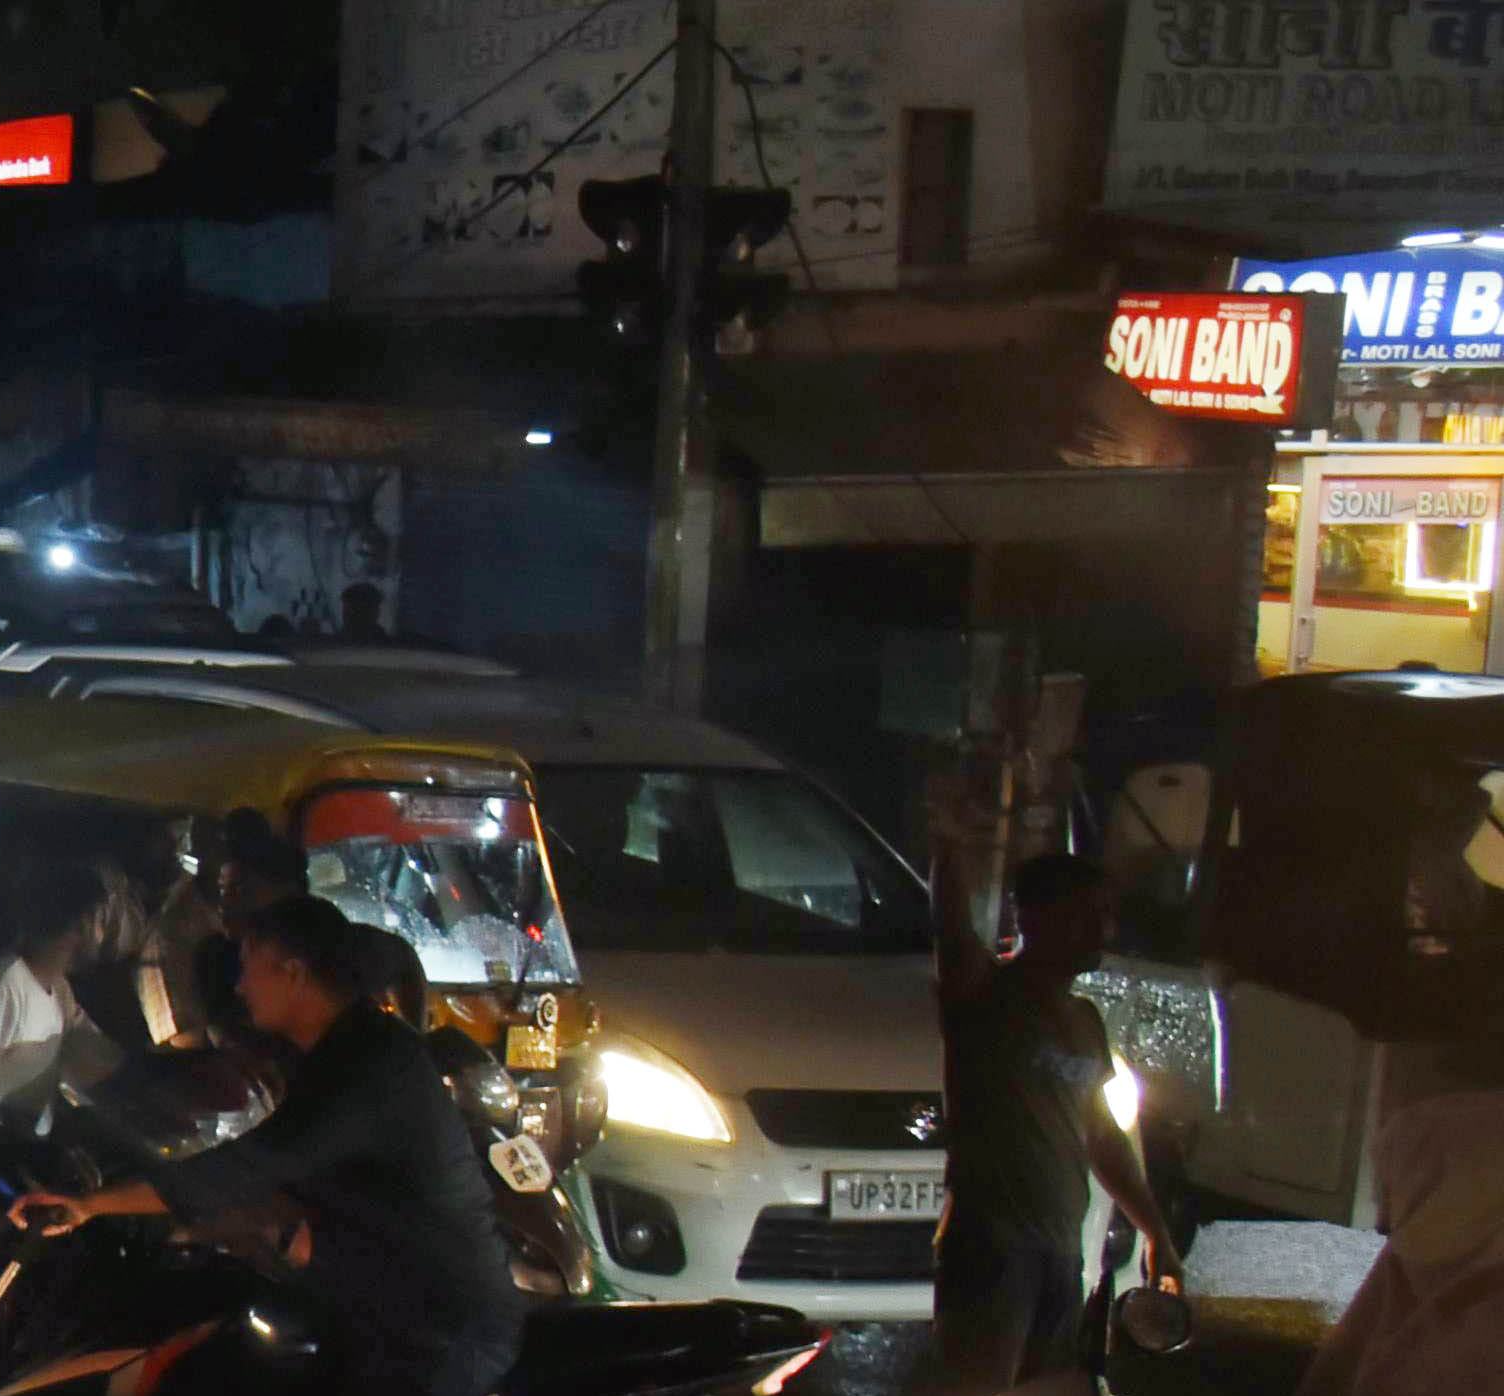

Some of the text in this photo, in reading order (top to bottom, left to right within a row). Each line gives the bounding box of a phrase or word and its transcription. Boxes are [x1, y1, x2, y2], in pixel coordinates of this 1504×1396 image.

[1104, 314, 1293, 387] SONI BAND
[1360, 345, 1409, 360] MOTI
[1412, 346, 1449, 360] LAL
[1453, 343, 1501, 359] SONI
[1328, 490, 1488, 519] SONI BAND
